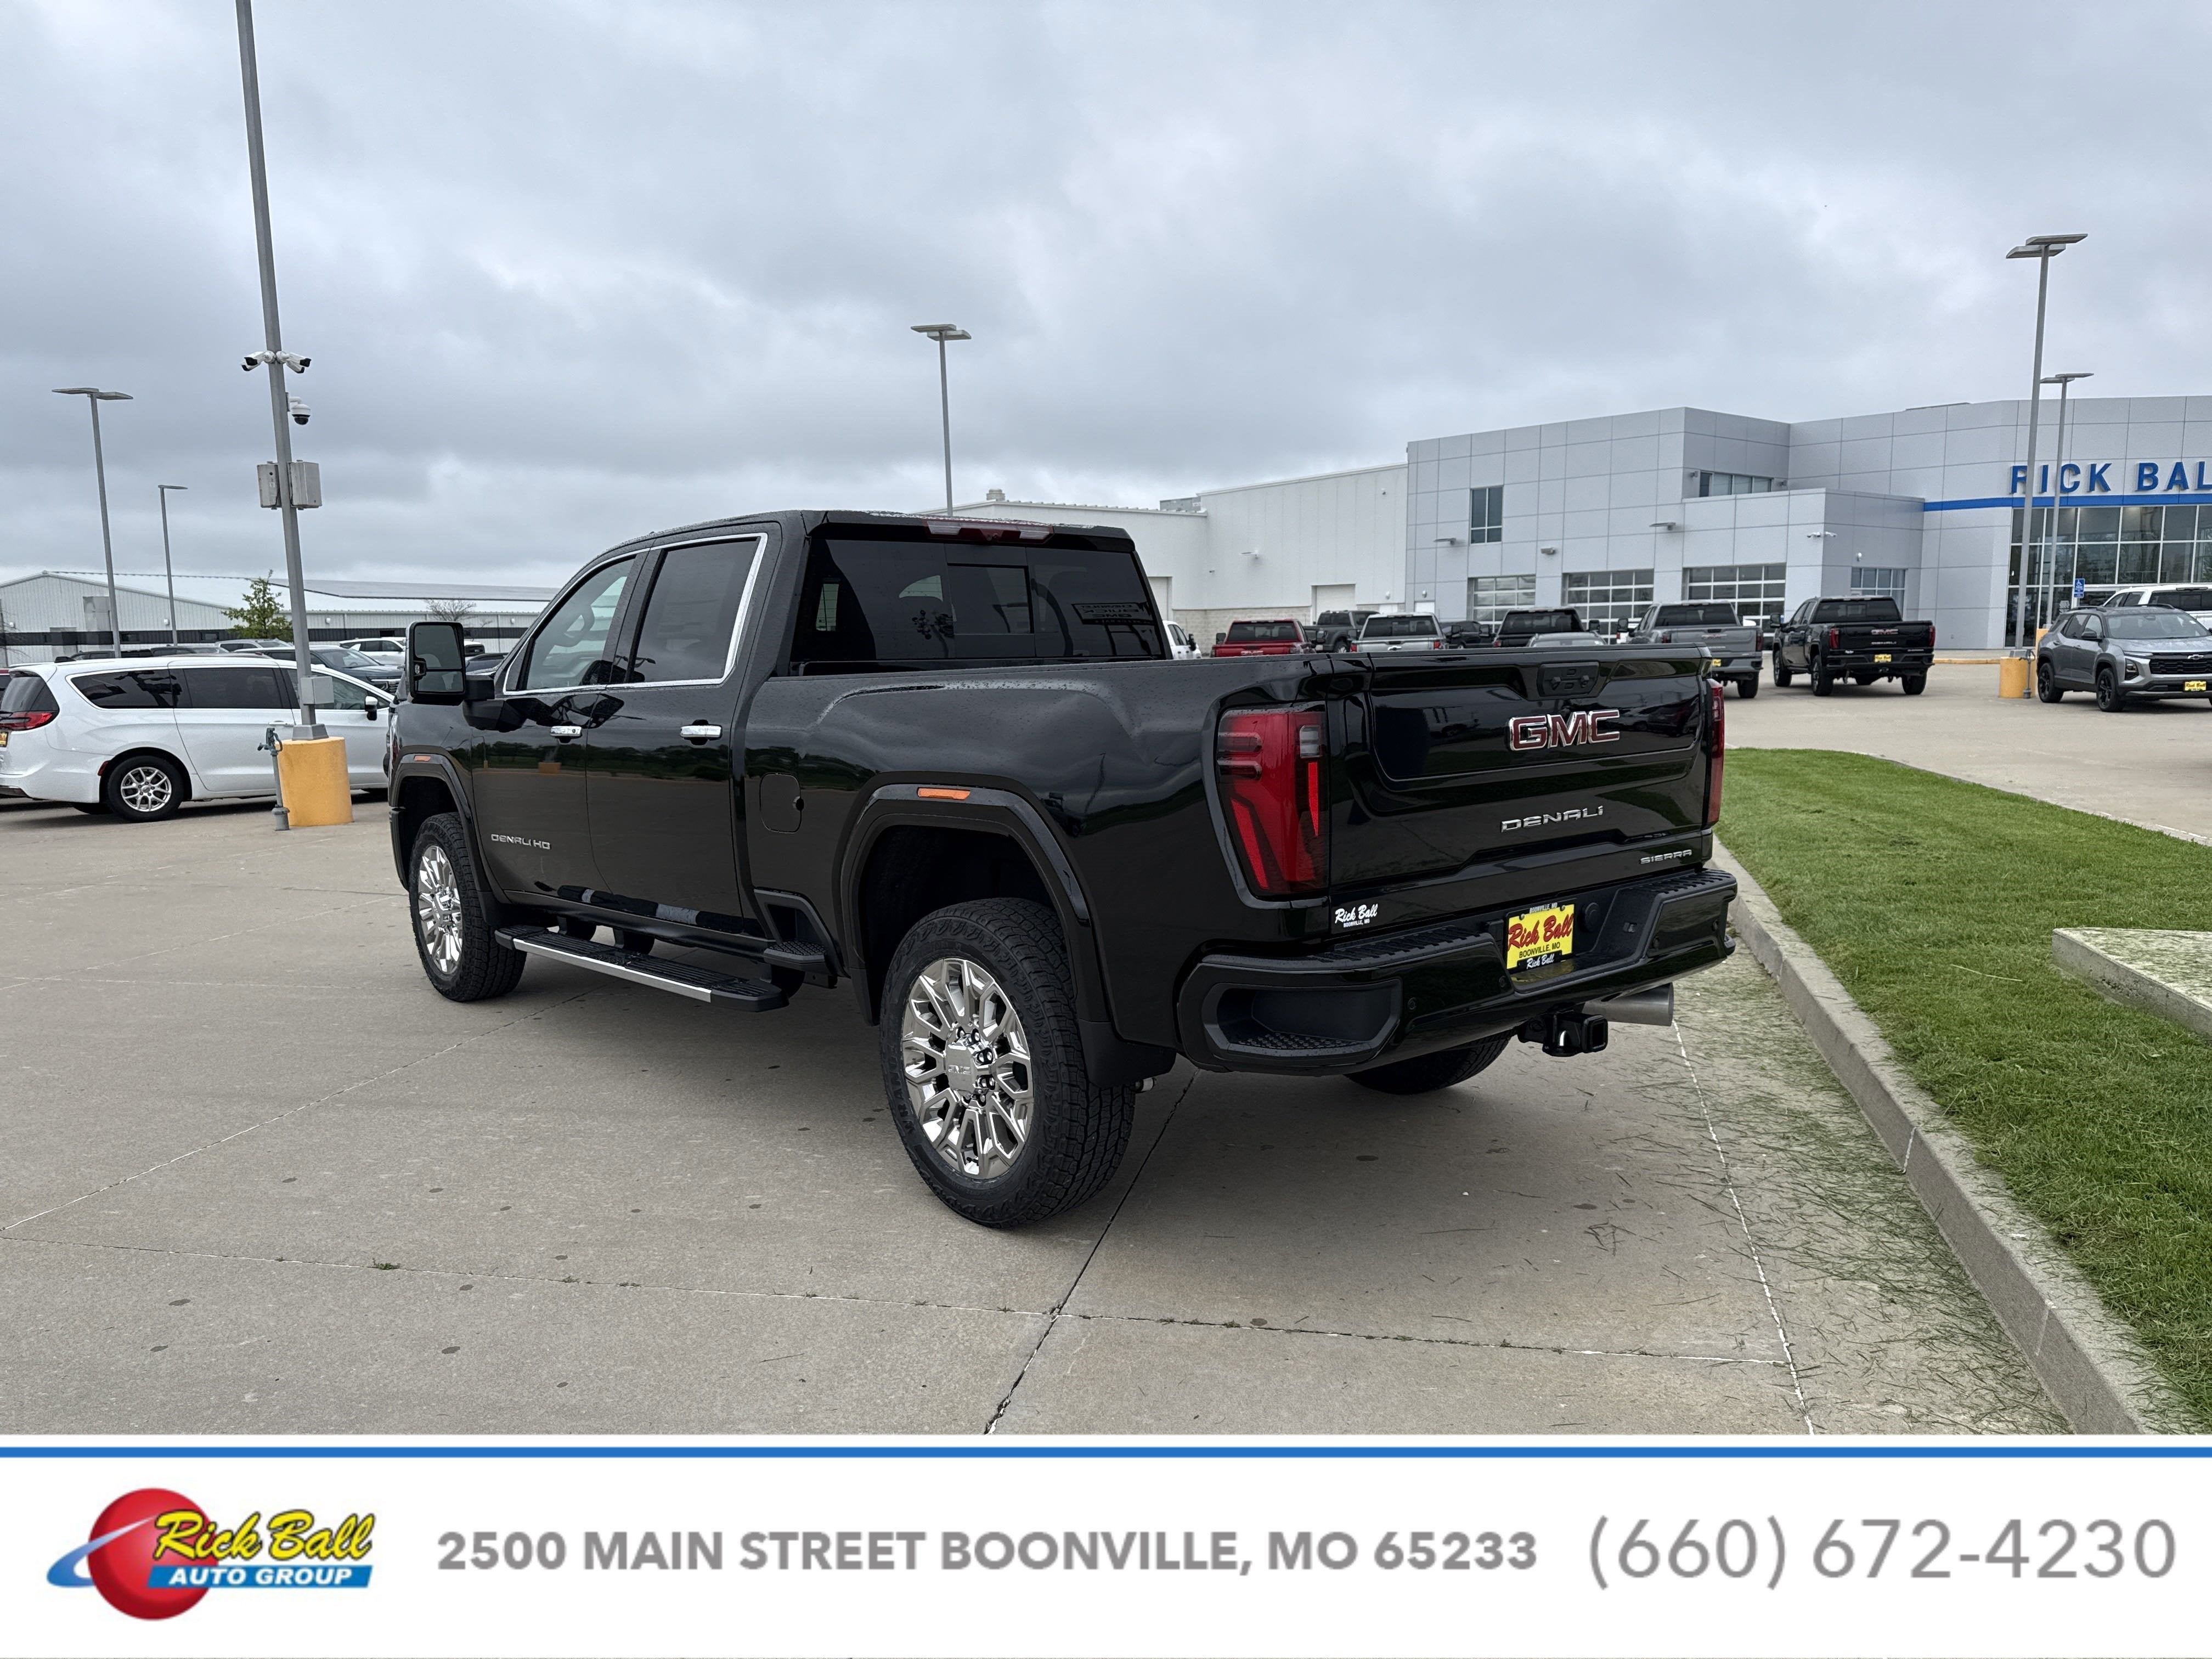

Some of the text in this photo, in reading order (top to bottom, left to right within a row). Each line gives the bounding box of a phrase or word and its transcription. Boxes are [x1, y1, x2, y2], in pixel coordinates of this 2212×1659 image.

[2011, 463, 2111, 493] RICK
[1509, 709, 1620, 751] GMC
[1500, 805, 1604, 833] DENALI
[491, 834, 551, 850] DENALI HD
[1640, 849, 1692, 865] SIERRA
[1335, 903, 1378, 924] Rick Ball
[1508, 913, 1574, 951] Rick Ball
[1519, 942, 1560, 958] BOONVILLE, MO
[1526, 953, 1555, 969] Rick Ball
